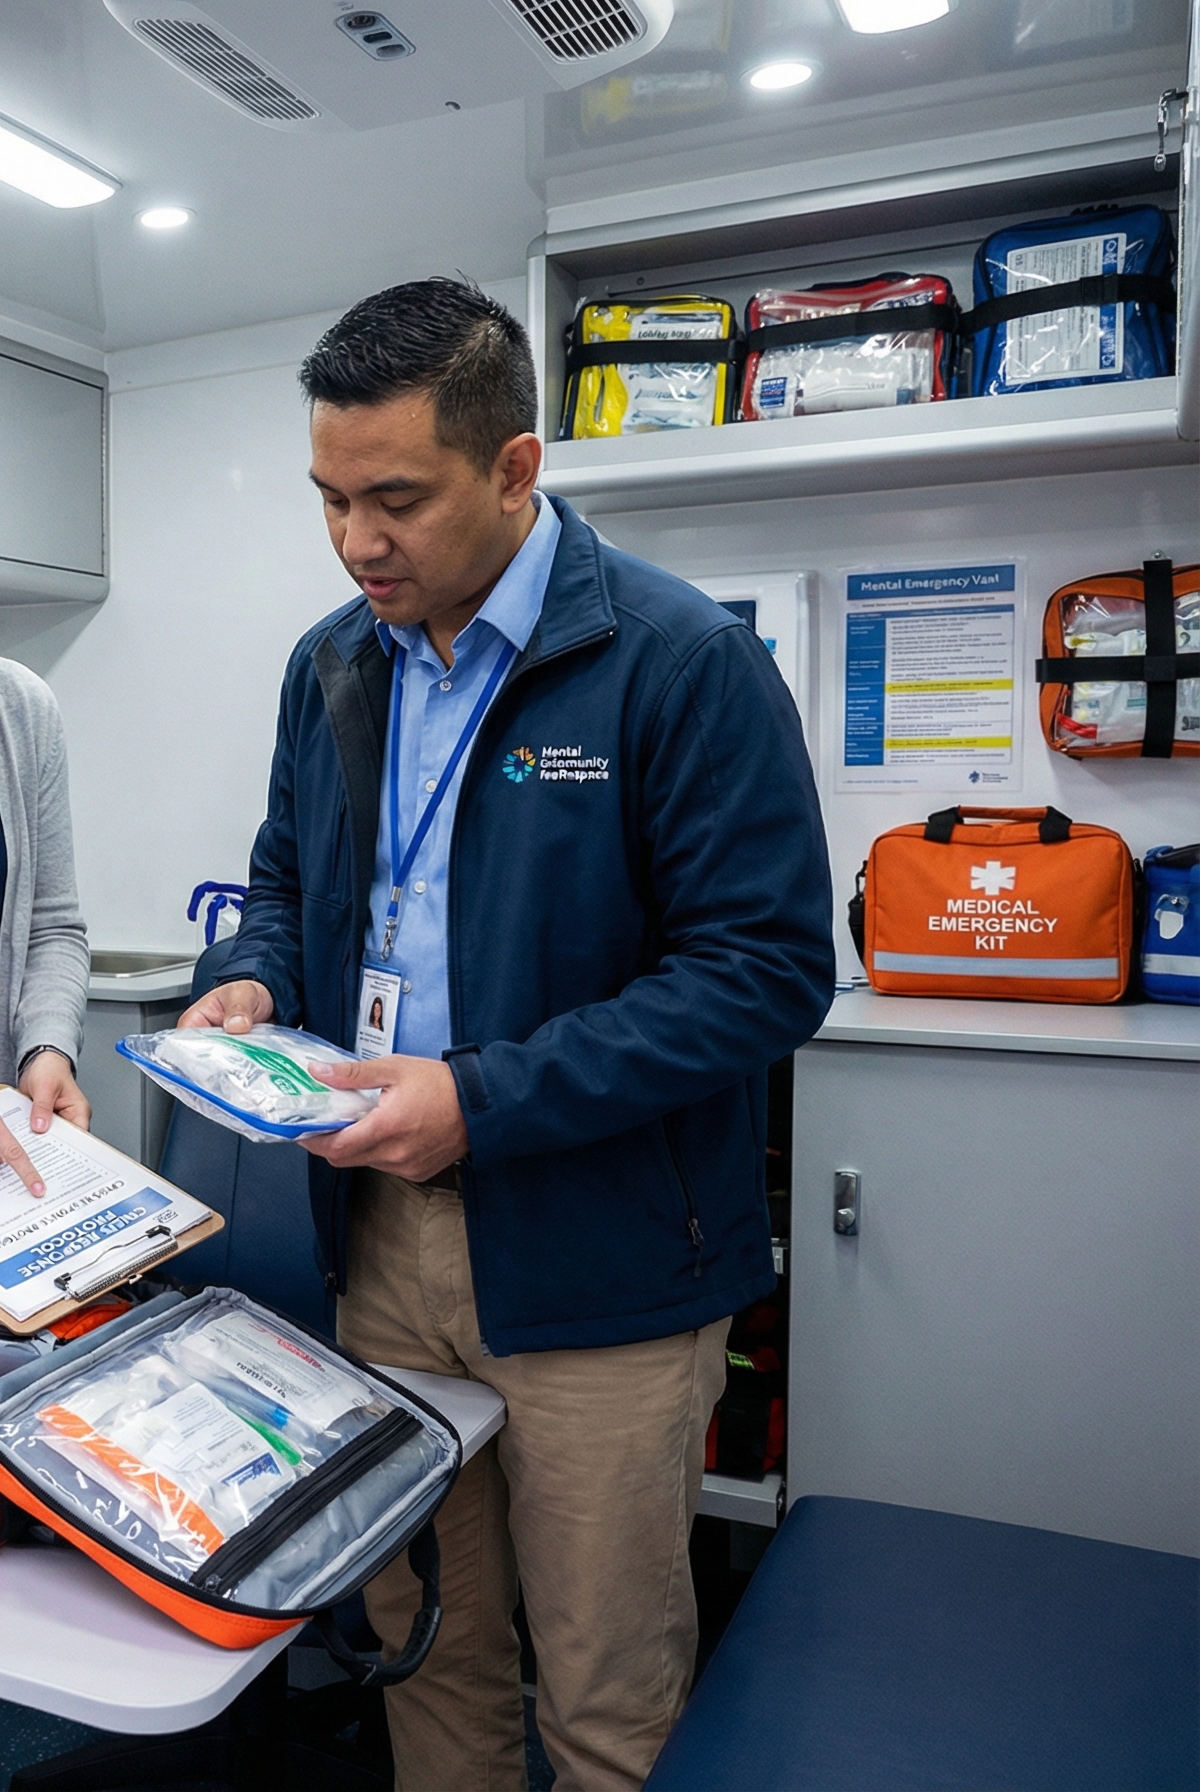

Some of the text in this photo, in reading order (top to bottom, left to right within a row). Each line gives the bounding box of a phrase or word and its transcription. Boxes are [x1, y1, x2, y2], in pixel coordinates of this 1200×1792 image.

[860, 578, 902, 592] Mental
[542, 746, 582, 757] Mental
[946, 898, 1040, 915] MEDICAL
[927, 916, 1058, 933] EMERGENCY
[974, 935, 1008, 950] KIT
